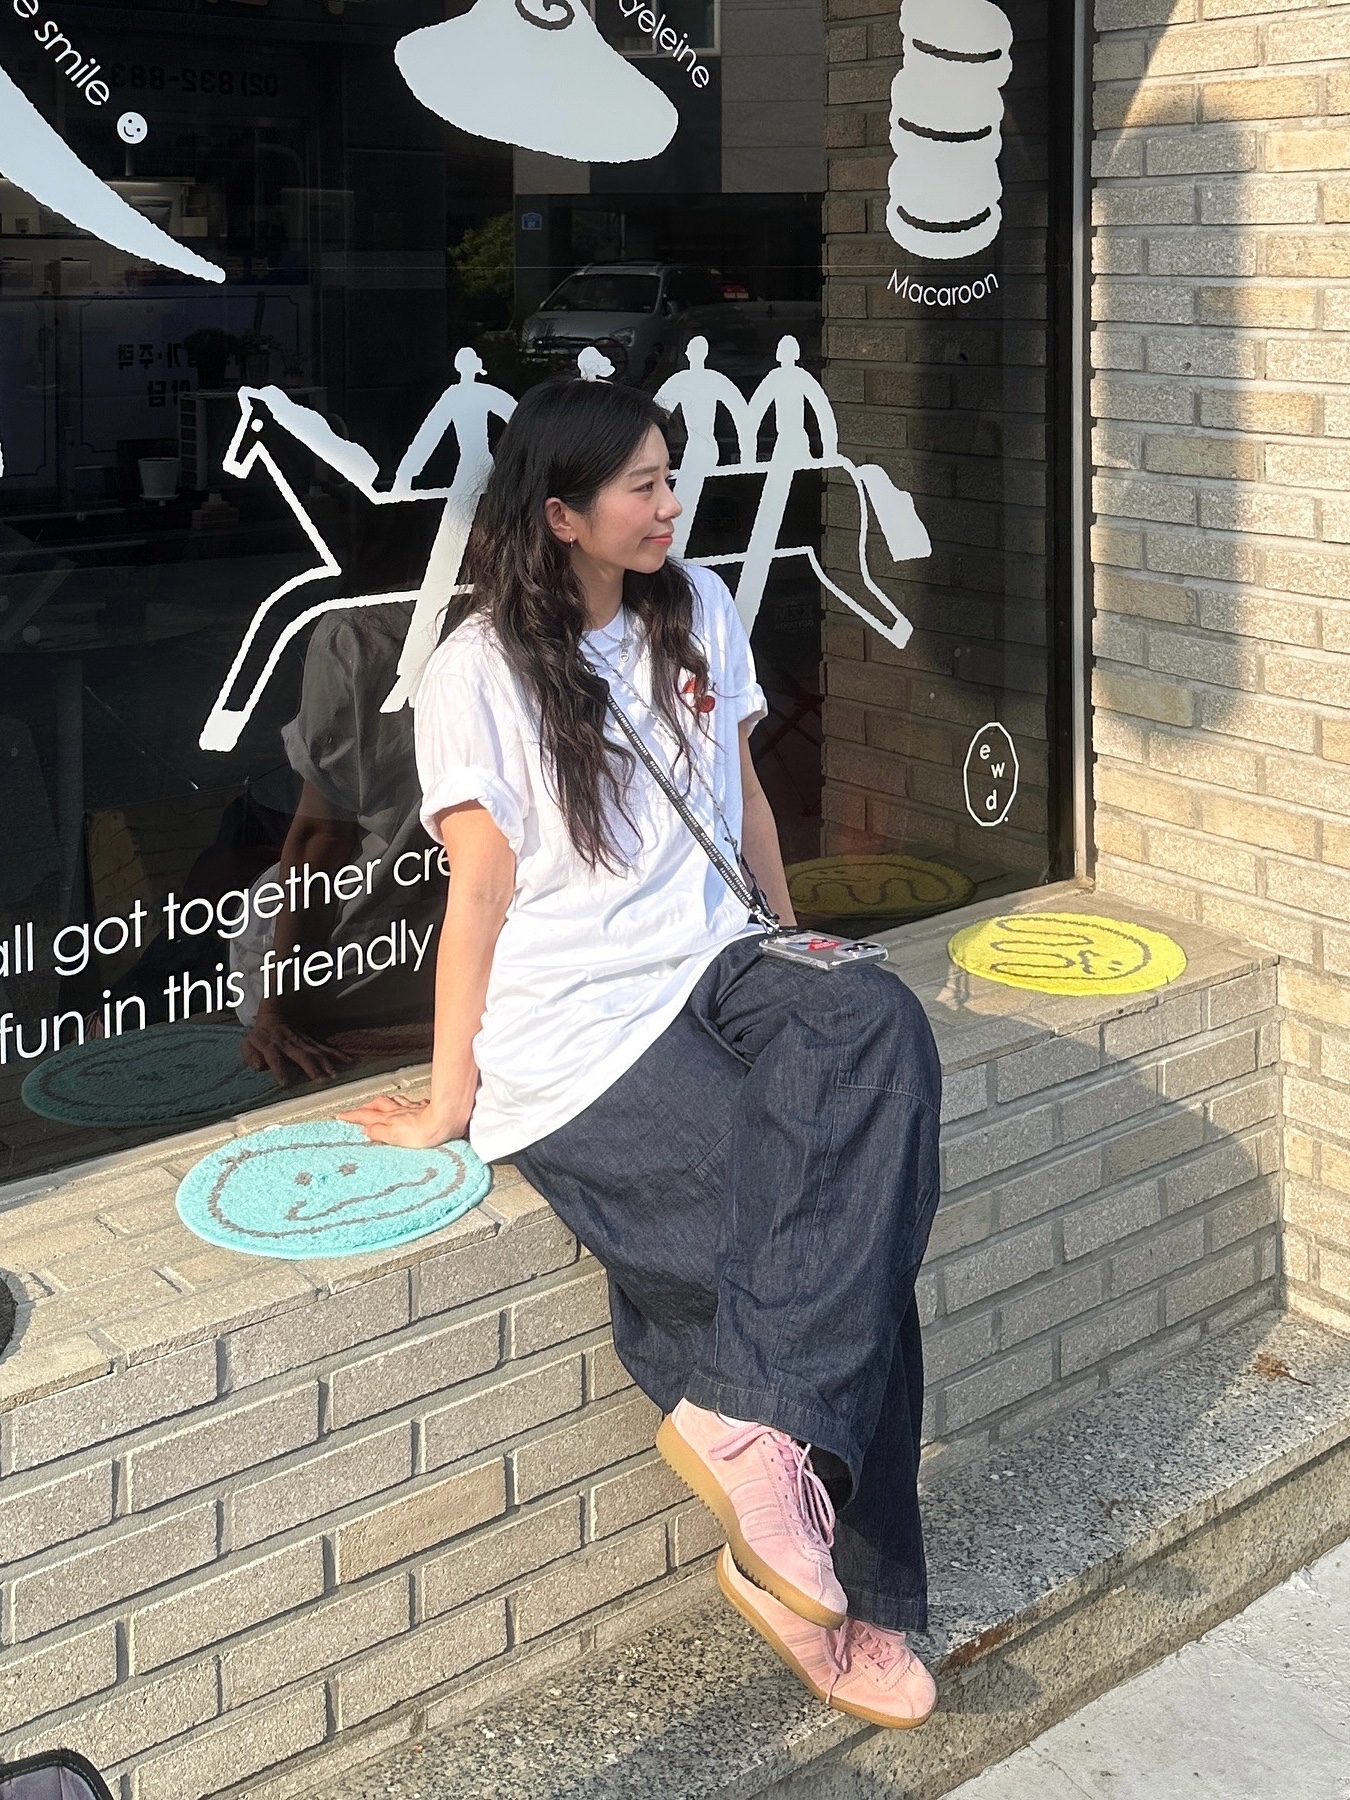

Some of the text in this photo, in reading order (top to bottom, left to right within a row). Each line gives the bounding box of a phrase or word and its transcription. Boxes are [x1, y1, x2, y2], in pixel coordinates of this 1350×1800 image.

[34, 21, 110, 106] smile
[886, 268, 999, 307] Macaroon
[0, 921, 34, 977] ll
[53, 899, 148, 977] got
[162, 858, 382, 939] together
[0, 918, 434, 1065] fun in this friendly
